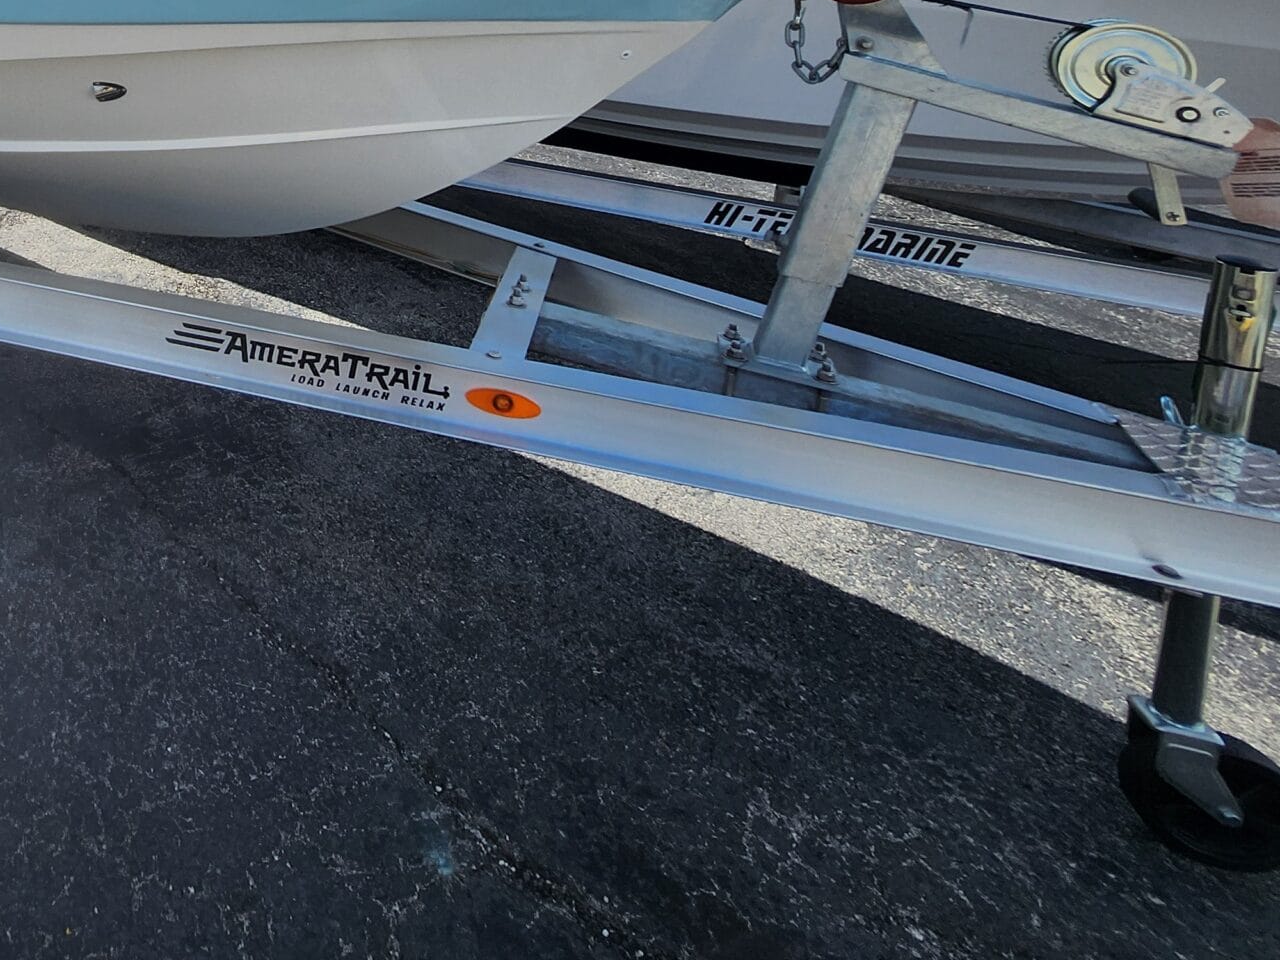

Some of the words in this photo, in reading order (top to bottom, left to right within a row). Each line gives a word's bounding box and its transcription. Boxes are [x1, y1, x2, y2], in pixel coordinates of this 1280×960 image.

[703, 201, 796, 234] HI-TE
[290, 373, 325, 388] LOAD
[334, 382, 391, 402] LAUNCH
[400, 393, 447, 412] RELAX
